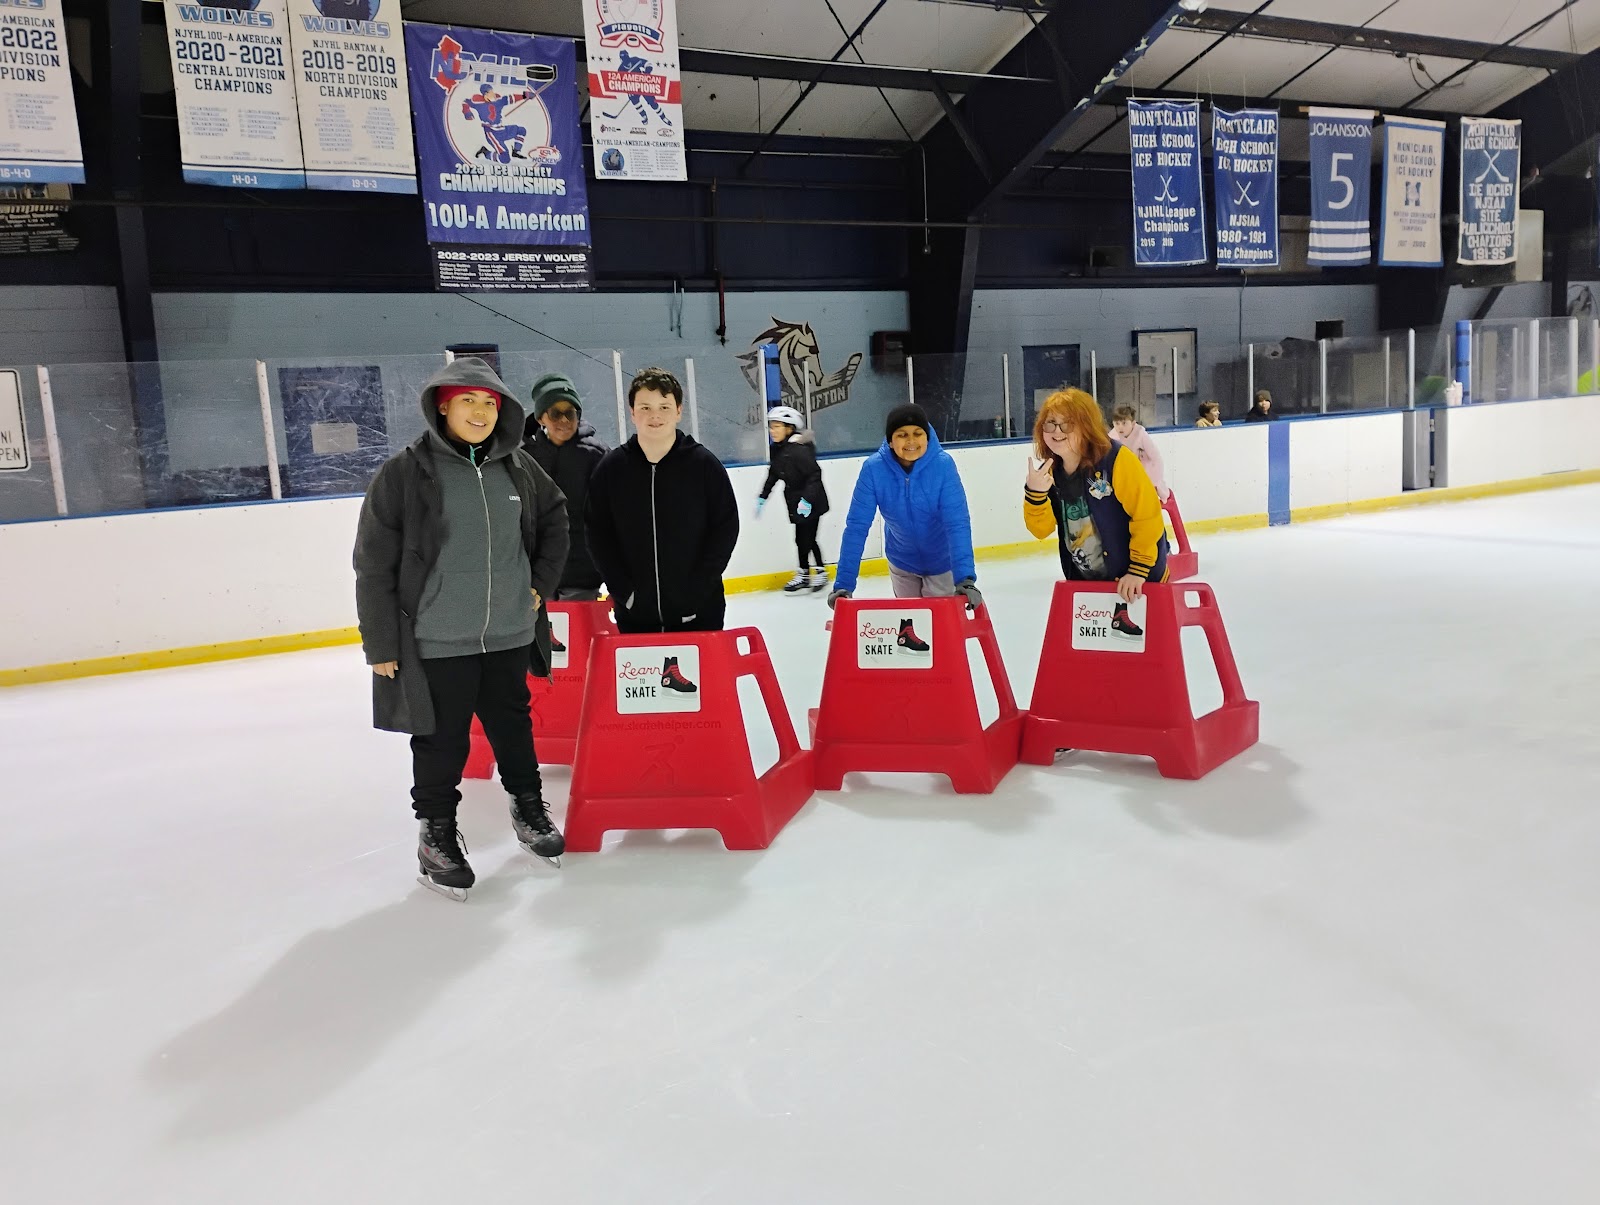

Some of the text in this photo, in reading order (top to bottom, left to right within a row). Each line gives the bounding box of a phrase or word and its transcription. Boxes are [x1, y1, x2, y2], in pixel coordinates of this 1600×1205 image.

[176, 4, 274, 28] WOLVES
[300, 15, 390, 38] WOLVES
[175, 28, 206, 39] NJYHL
[236, 34, 282, 45] AMERICAN
[312, 39, 385, 53] NJYHL BANTAM A
[0, 51, 61, 67] IVISION
[178, 63, 285, 80] CENTRAL DIVISION
[608, 72, 661, 84] 12A AMERICAN
[195, 78, 272, 94] CHAMPIONS
[304, 71, 398, 88] NORTH DIVISION
[608, 80, 661, 94] CHAMPIONS
[320, 86, 387, 101] CHAMPIONS
[1131, 110, 1197, 126] MONTCLAIR
[1310, 122, 1372, 138] JOHANSSON
[1132, 134, 1195, 148] HIGH SCHOOL
[1240, 140, 1276, 155] SCHOOL
[1135, 152, 1192, 167] ICE HOCKEY
[1234, 158, 1273, 173] HOCKEY
[455, 163, 552, 178] 2023 ICE HOCKEY
[232, 175, 258, 185] 14-0-1
[352, 178, 378, 188] 19-0-3
[440, 173, 566, 196] CHAMPIONSHIPS
[1328, 152, 1354, 210] 5
[428, 202, 586, 231] 10U-A American
[1165, 206, 1196, 220] League
[1229, 214, 1260, 227] NJSIAA
[1144, 220, 1190, 234] Champions
[1140, 238, 1156, 247] 2015
[437, 251, 587, 262] 2022-2023 JERSEY WOLVES
[1217, 247, 1273, 261] tate Champions
[1, 430, 12, 443] NI
[1075, 604, 1113, 620] Learn
[860, 622, 899, 639] Learn
[1080, 626, 1107, 637] SKATE
[865, 644, 893, 655] SKATE
[619, 661, 662, 680] Learn
[625, 686, 657, 698] SKATE
